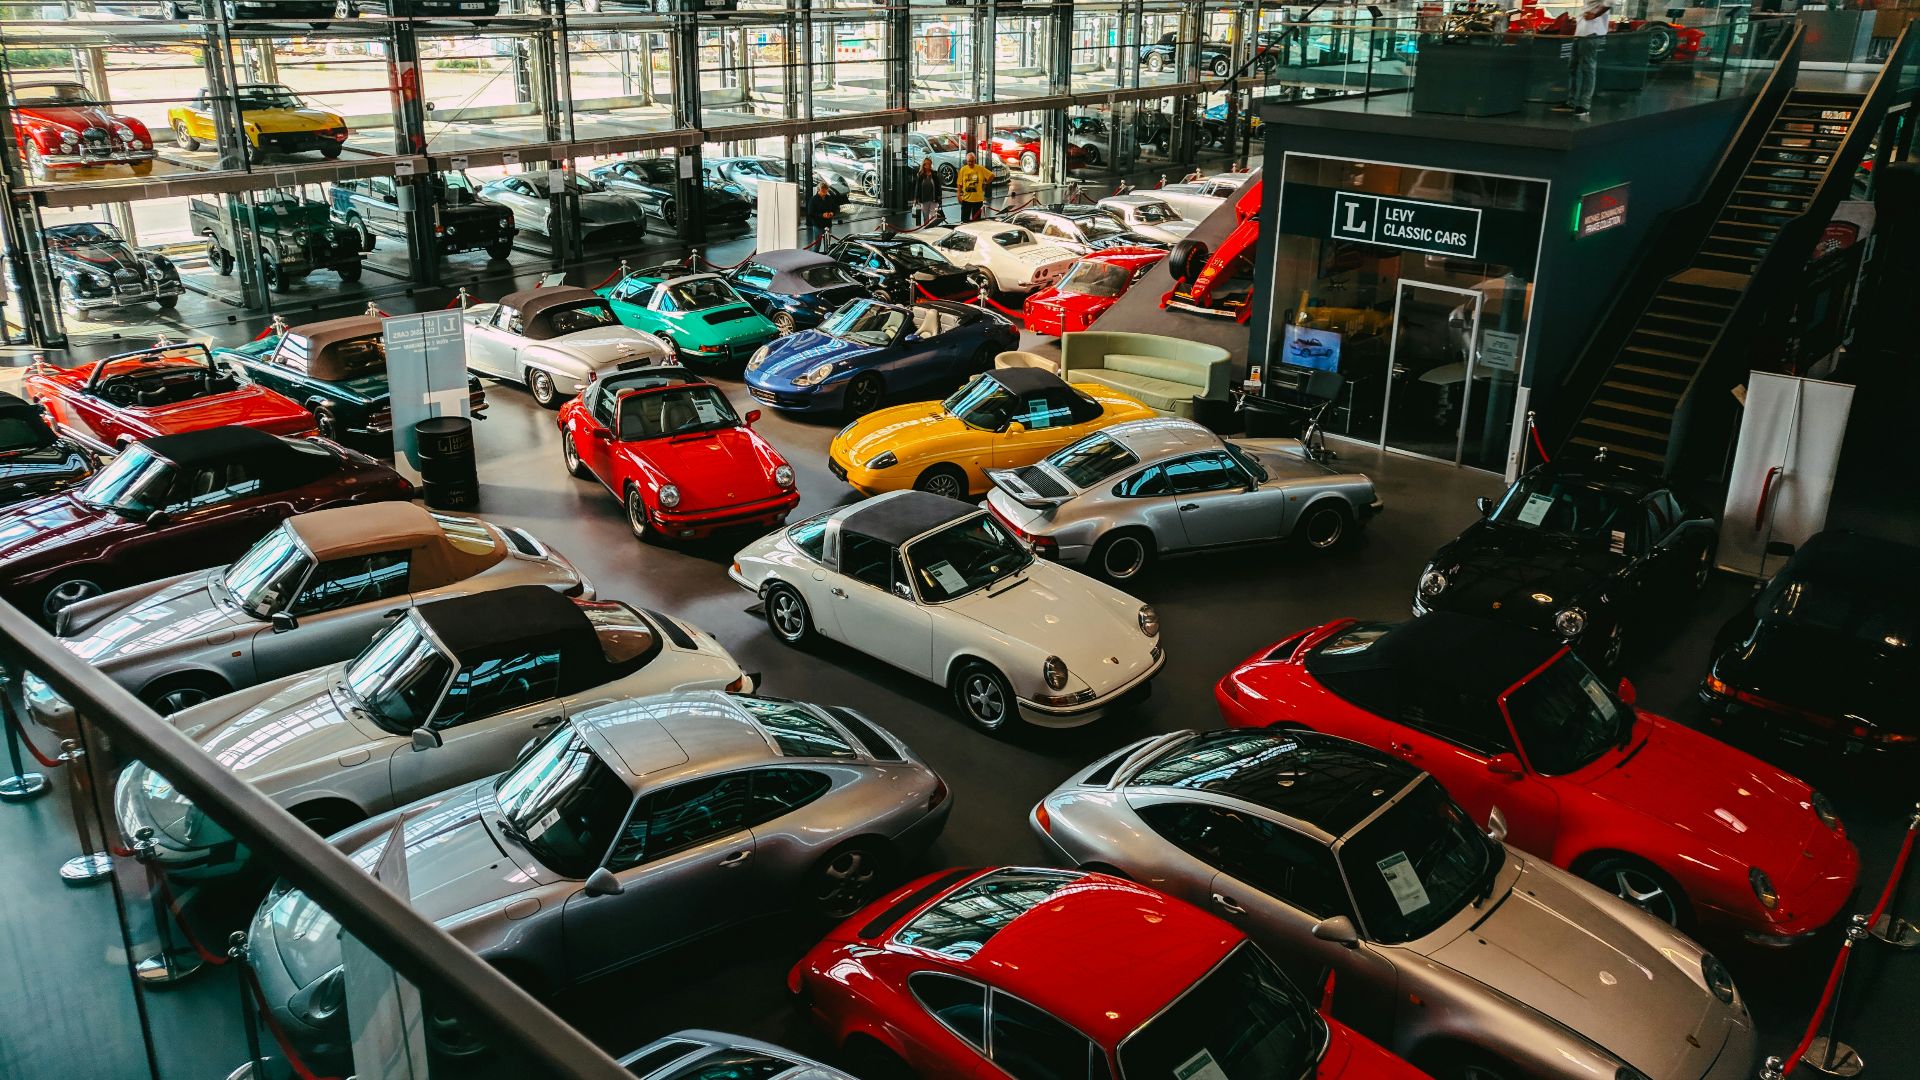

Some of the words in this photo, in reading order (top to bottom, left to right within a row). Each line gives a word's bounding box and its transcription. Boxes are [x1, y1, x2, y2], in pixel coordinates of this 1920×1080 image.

[400, 23, 409, 31] 13
[1342, 201, 1367, 233] L
[1385, 207, 1415, 222] LEVY
[1383, 223, 1432, 241] CLASSIC
[1434, 230, 1467, 246] CARS
